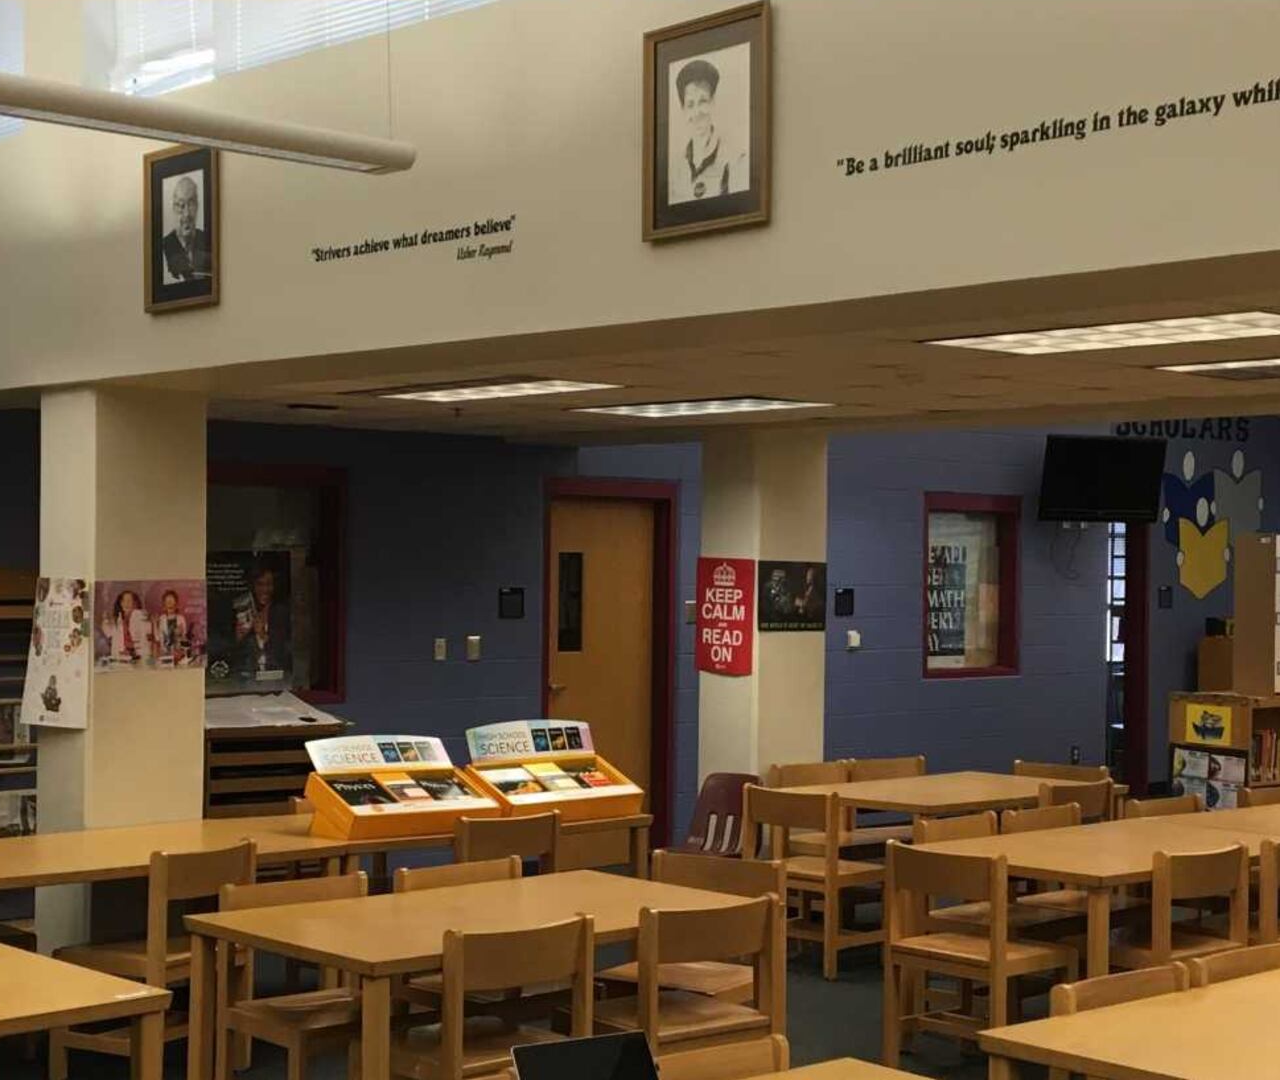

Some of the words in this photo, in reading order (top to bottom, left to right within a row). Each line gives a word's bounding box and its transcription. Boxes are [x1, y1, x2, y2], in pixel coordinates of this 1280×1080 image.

[836, 157, 865, 176] "Be
[869, 160, 878, 171] a
[885, 141, 950, 169] brilliant
[1000, 118, 1086, 151] sparkling
[1092, 111, 1111, 132] in
[1118, 105, 1149, 128] the
[1154, 93, 1225, 126] galaxy
[353, 237, 390, 257] achieve
[392, 232, 418, 250] what
[421, 226, 471, 246] dreamers
[705, 588, 743, 604] KEEP
[701, 603, 745, 621] CALM
[702, 628, 742, 646] READ
[710, 645, 733, 662] ON
[480, 740, 531, 755] SCIENCE
[322, 751, 377, 765] SCIENCE
